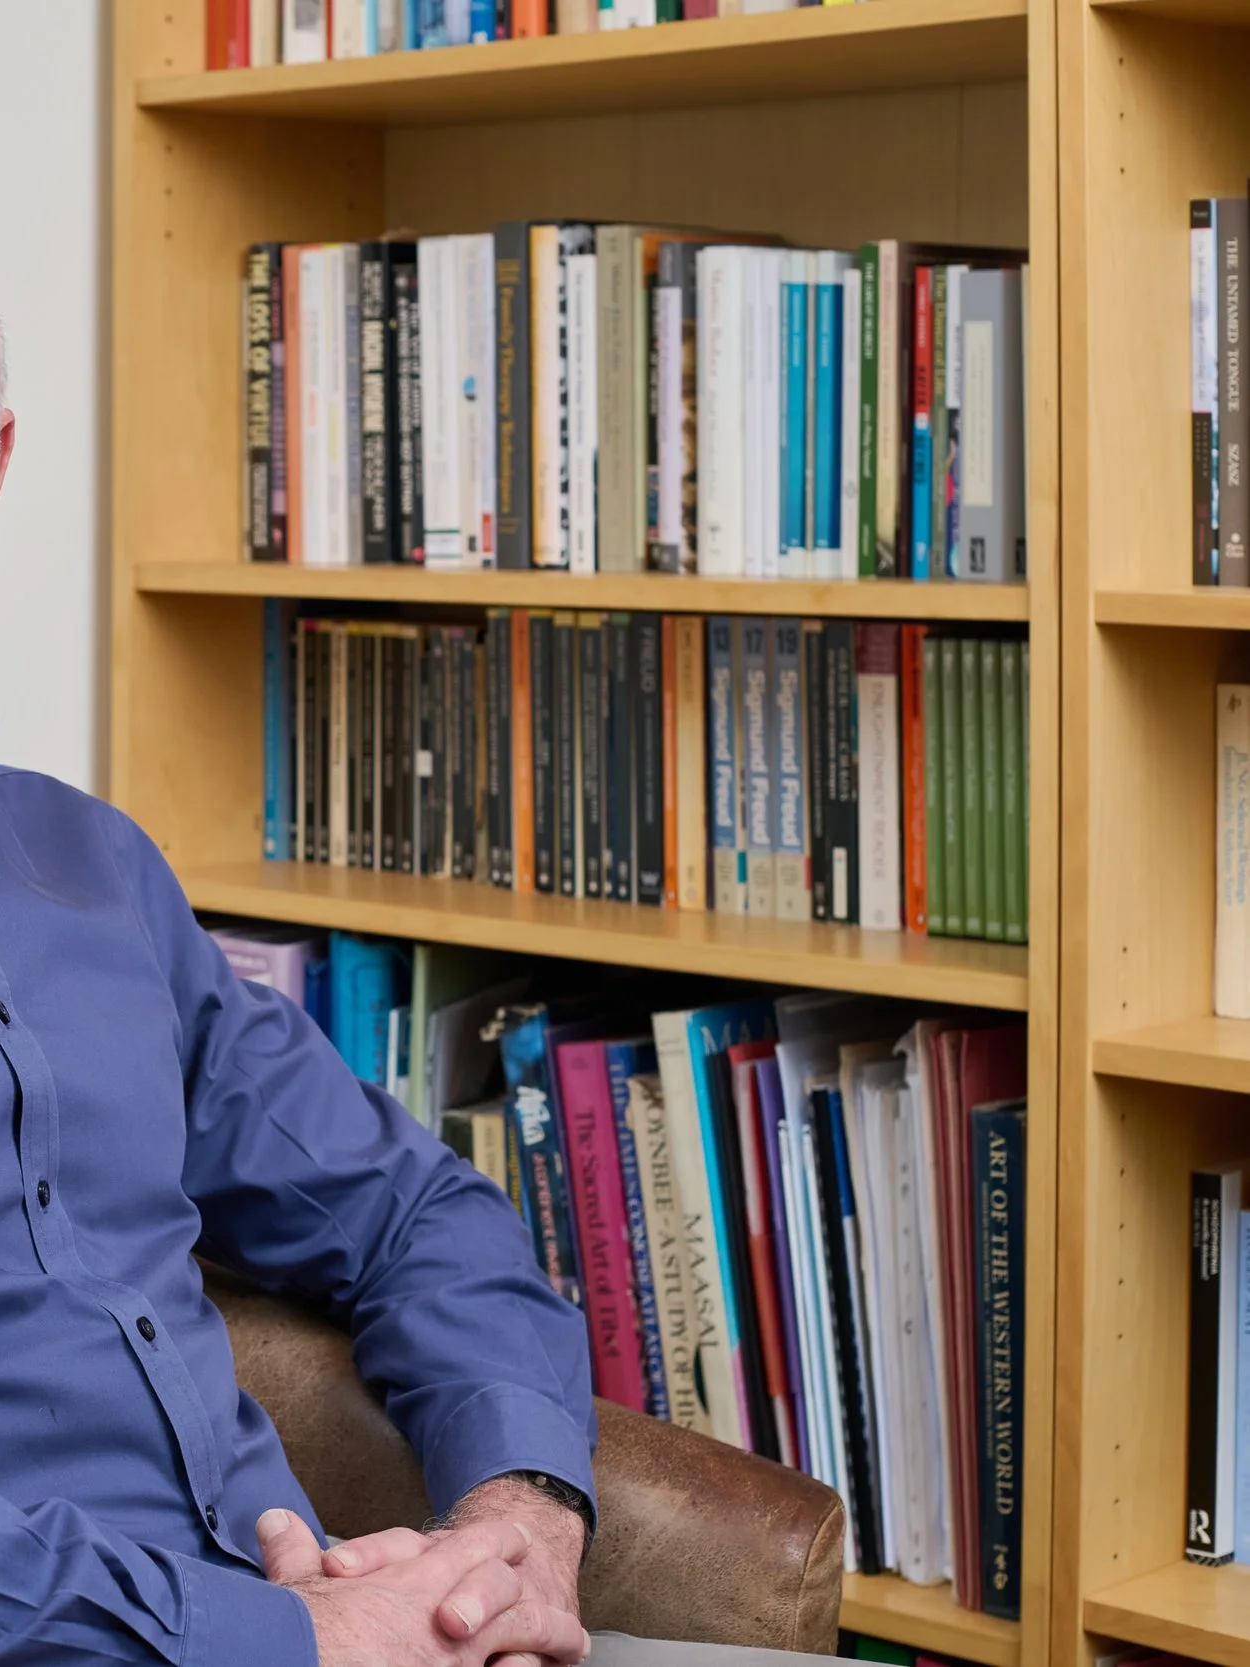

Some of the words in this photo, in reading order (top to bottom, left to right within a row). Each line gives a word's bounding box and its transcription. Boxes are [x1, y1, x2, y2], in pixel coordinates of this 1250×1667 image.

[249, 253, 269, 287] THE
[1226, 237, 1238, 269] THE
[249, 293, 269, 342] LOSS
[499, 287, 515, 343] Family
[1226, 275, 1239, 343] UNTAMED
[249, 347, 269, 374] OF
[498, 347, 516, 417] Therapy
[1227, 348, 1240, 412] TONGUE
[249, 379, 270, 449] VIRTUE
[499, 421, 516, 515] Techniques
[1228, 443, 1240, 487] SZASZ
[710, 666, 733, 760] Sigmund
[743, 669, 770, 773] Sigmund
[777, 668, 799, 774] Sigmund
[871, 680, 888, 813] ENLIGHTENMENT
[713, 764, 734, 828] Freud
[750, 777, 772, 844] Freud
[780, 777, 802, 847] Freud
[872, 817, 888, 882] READER
[573, 1107, 597, 1151] The
[988, 1130, 1008, 1184] ART
[580, 1154, 607, 1230] Sacred
[989, 1188, 1008, 1227] OF
[591, 1234, 613, 1270] Art
[658, 1230, 677, 1249] A
[990, 1230, 1010, 1285] THE
[595, 1274, 616, 1297] of
[662, 1253, 687, 1339] STUDY
[683, 1213, 719, 1351] MAASAI
[598, 1304, 621, 1359] Tibet
[672, 1346, 693, 1380] OF
[991, 1290, 1013, 1414] WESTERN
[994, 1420, 1014, 1517] WORLD
